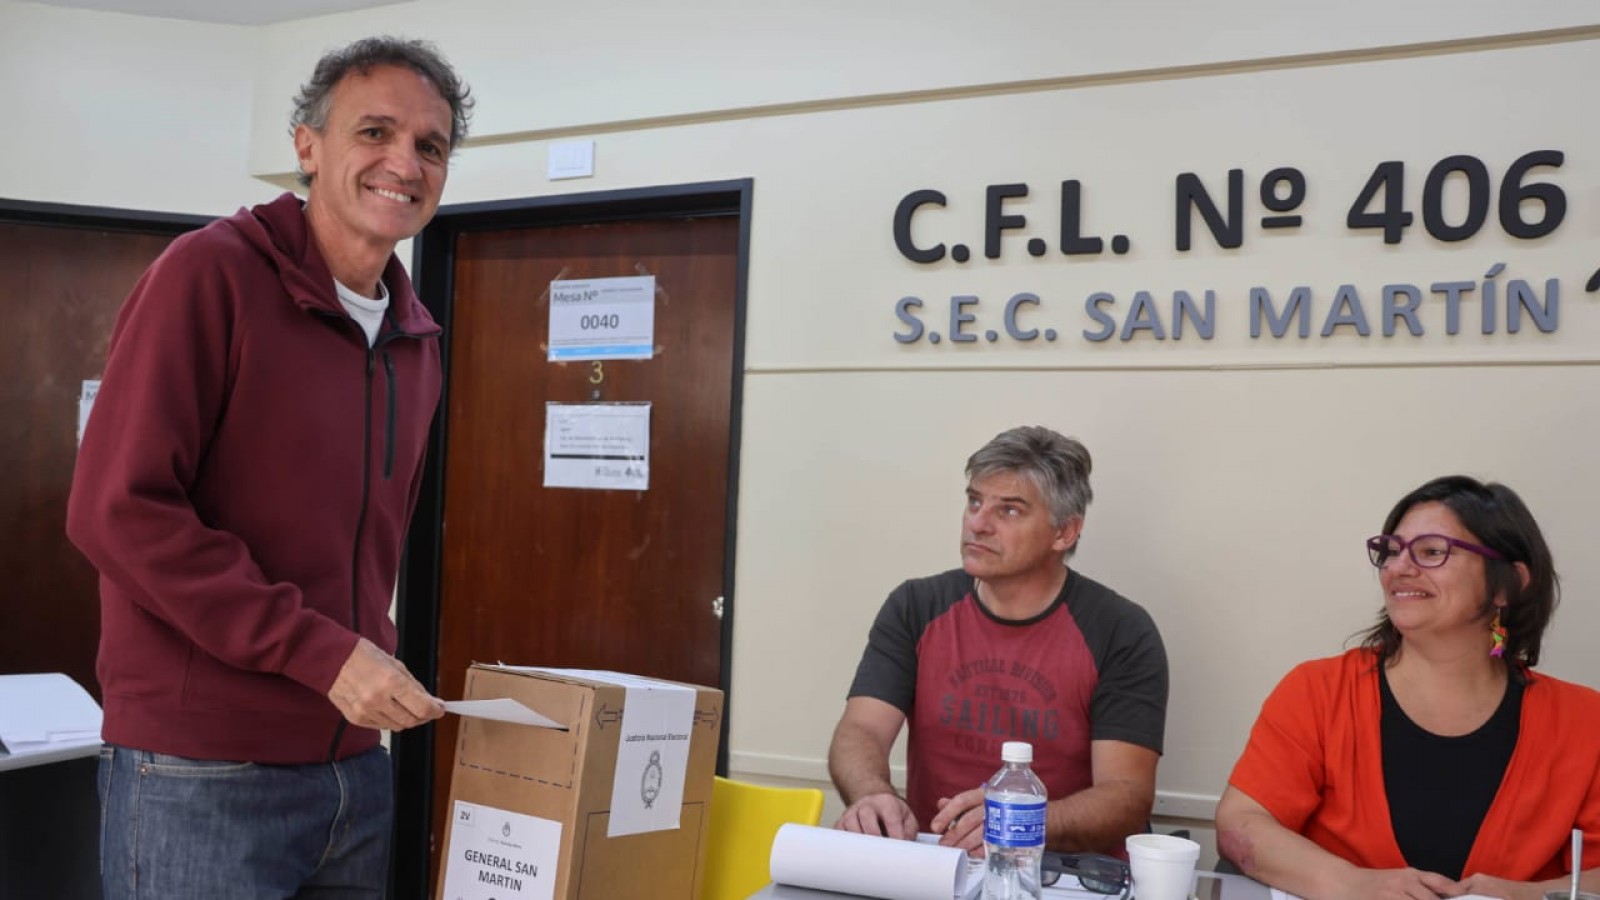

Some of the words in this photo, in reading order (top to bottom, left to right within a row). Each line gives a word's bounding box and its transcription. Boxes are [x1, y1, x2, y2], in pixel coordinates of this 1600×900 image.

[893, 180, 1131, 263] C.F.L.
[1176, 167, 1307, 251] Nº
[1347, 150, 1567, 245] 406
[553, 291, 582, 303] Mesa
[893, 291, 1057, 344] S.E.C.
[1083, 289, 1217, 342] SAN
[1249, 263, 1560, 337] MARTÍN
[580, 314, 620, 330] 0040
[589, 360, 604, 384] 3
[939, 693, 1060, 740] SAILING
[464, 849, 512, 872] GENERAL
[514, 860, 539, 878] SAN
[478, 869, 523, 892] MARTIN
